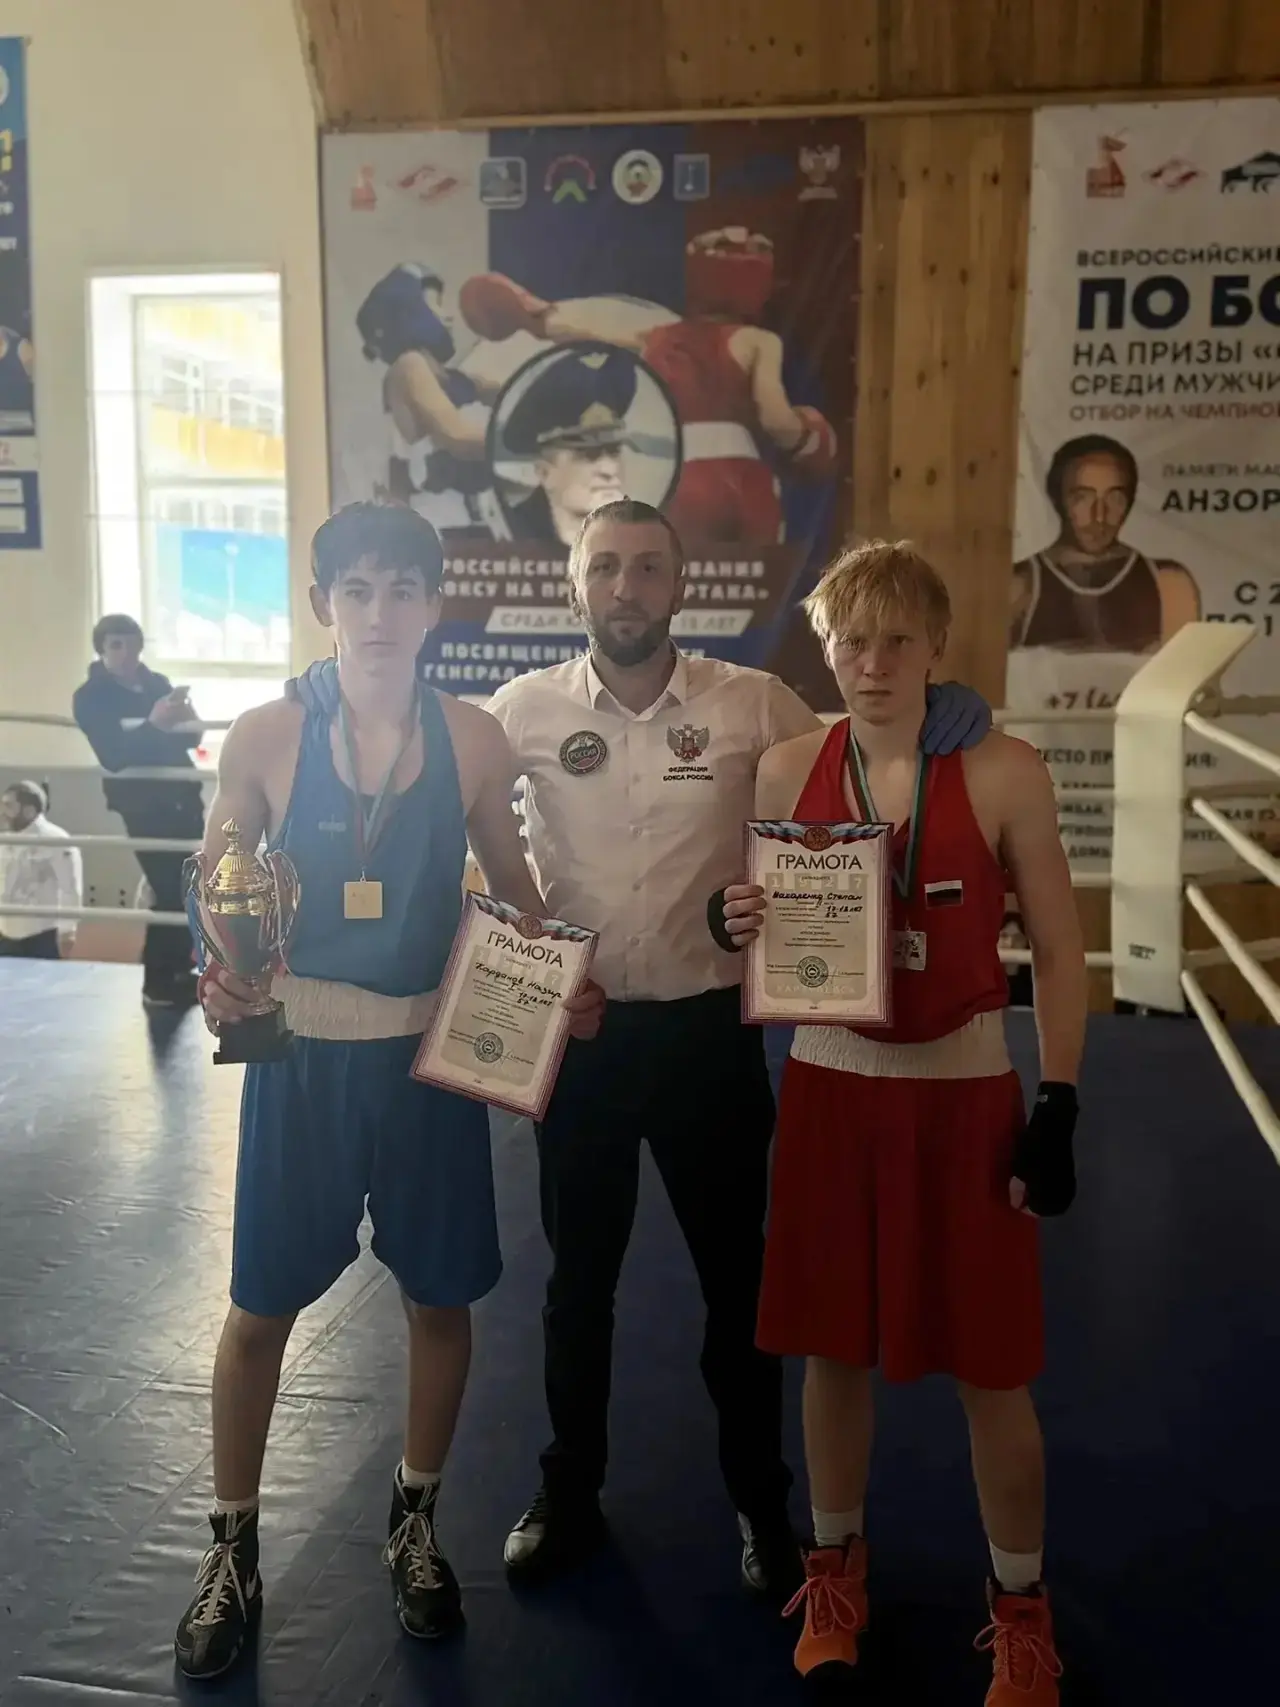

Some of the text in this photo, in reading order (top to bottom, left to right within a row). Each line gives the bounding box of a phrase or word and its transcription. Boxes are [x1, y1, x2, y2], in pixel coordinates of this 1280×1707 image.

[1078, 275, 1190, 330] ПО
[1073, 342, 1117, 367] НА
[1128, 339, 1242, 366] ПРИЗЫ
[1071, 373, 1164, 397] СРЕДИ
[1069, 403, 1141, 421] ОТБОР
[1145, 402, 1174, 421] НА
[1162, 488, 1280, 513] АНЗОР
[505, 581, 534, 598] НА
[1234, 581, 1258, 605] С
[777, 854, 862, 870] ГРАМОТА
[487, 930, 563, 968] ГРАМОТА
